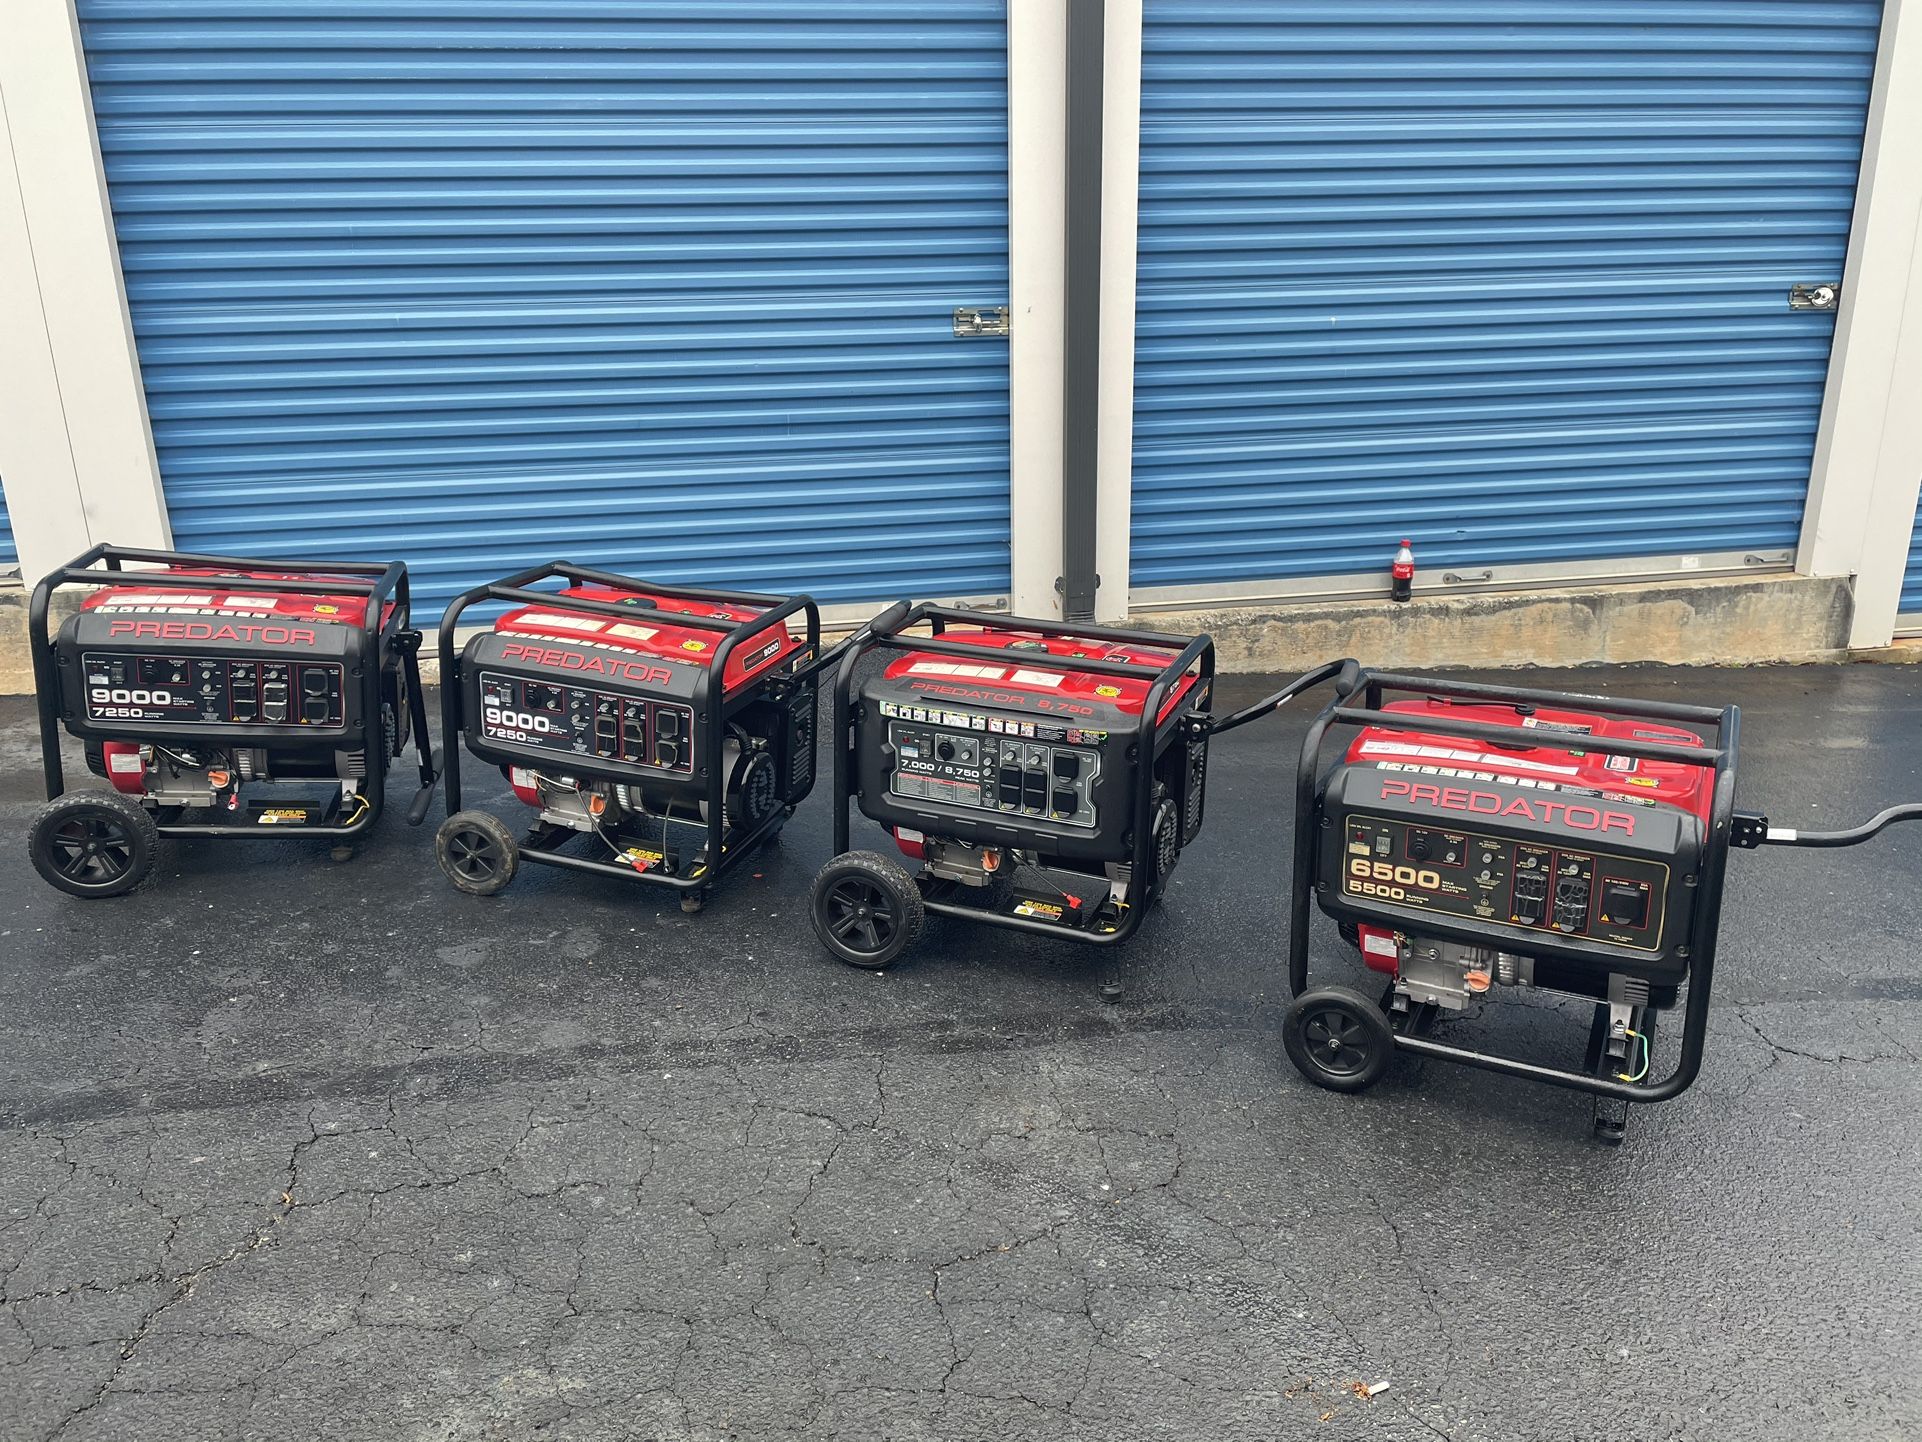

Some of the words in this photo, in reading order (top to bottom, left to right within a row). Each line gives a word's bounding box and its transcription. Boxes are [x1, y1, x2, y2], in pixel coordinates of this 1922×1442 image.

[109, 620, 316, 646] PREDATOR
[501, 643, 673, 686] PREDATOR
[91, 688, 171, 705] 9000
[910, 681, 1025, 705] PREDATOR
[1037, 699, 1094, 716] 8,750
[92, 707, 143, 718] 7250
[486, 707, 550, 733] 9000
[487, 726, 527, 742] 7250
[945, 766, 980, 778] 8,750
[1380, 779, 1636, 837] PREDATOR
[1350, 858, 1441, 890] 6500
[1348, 879, 1405, 900] 5500
